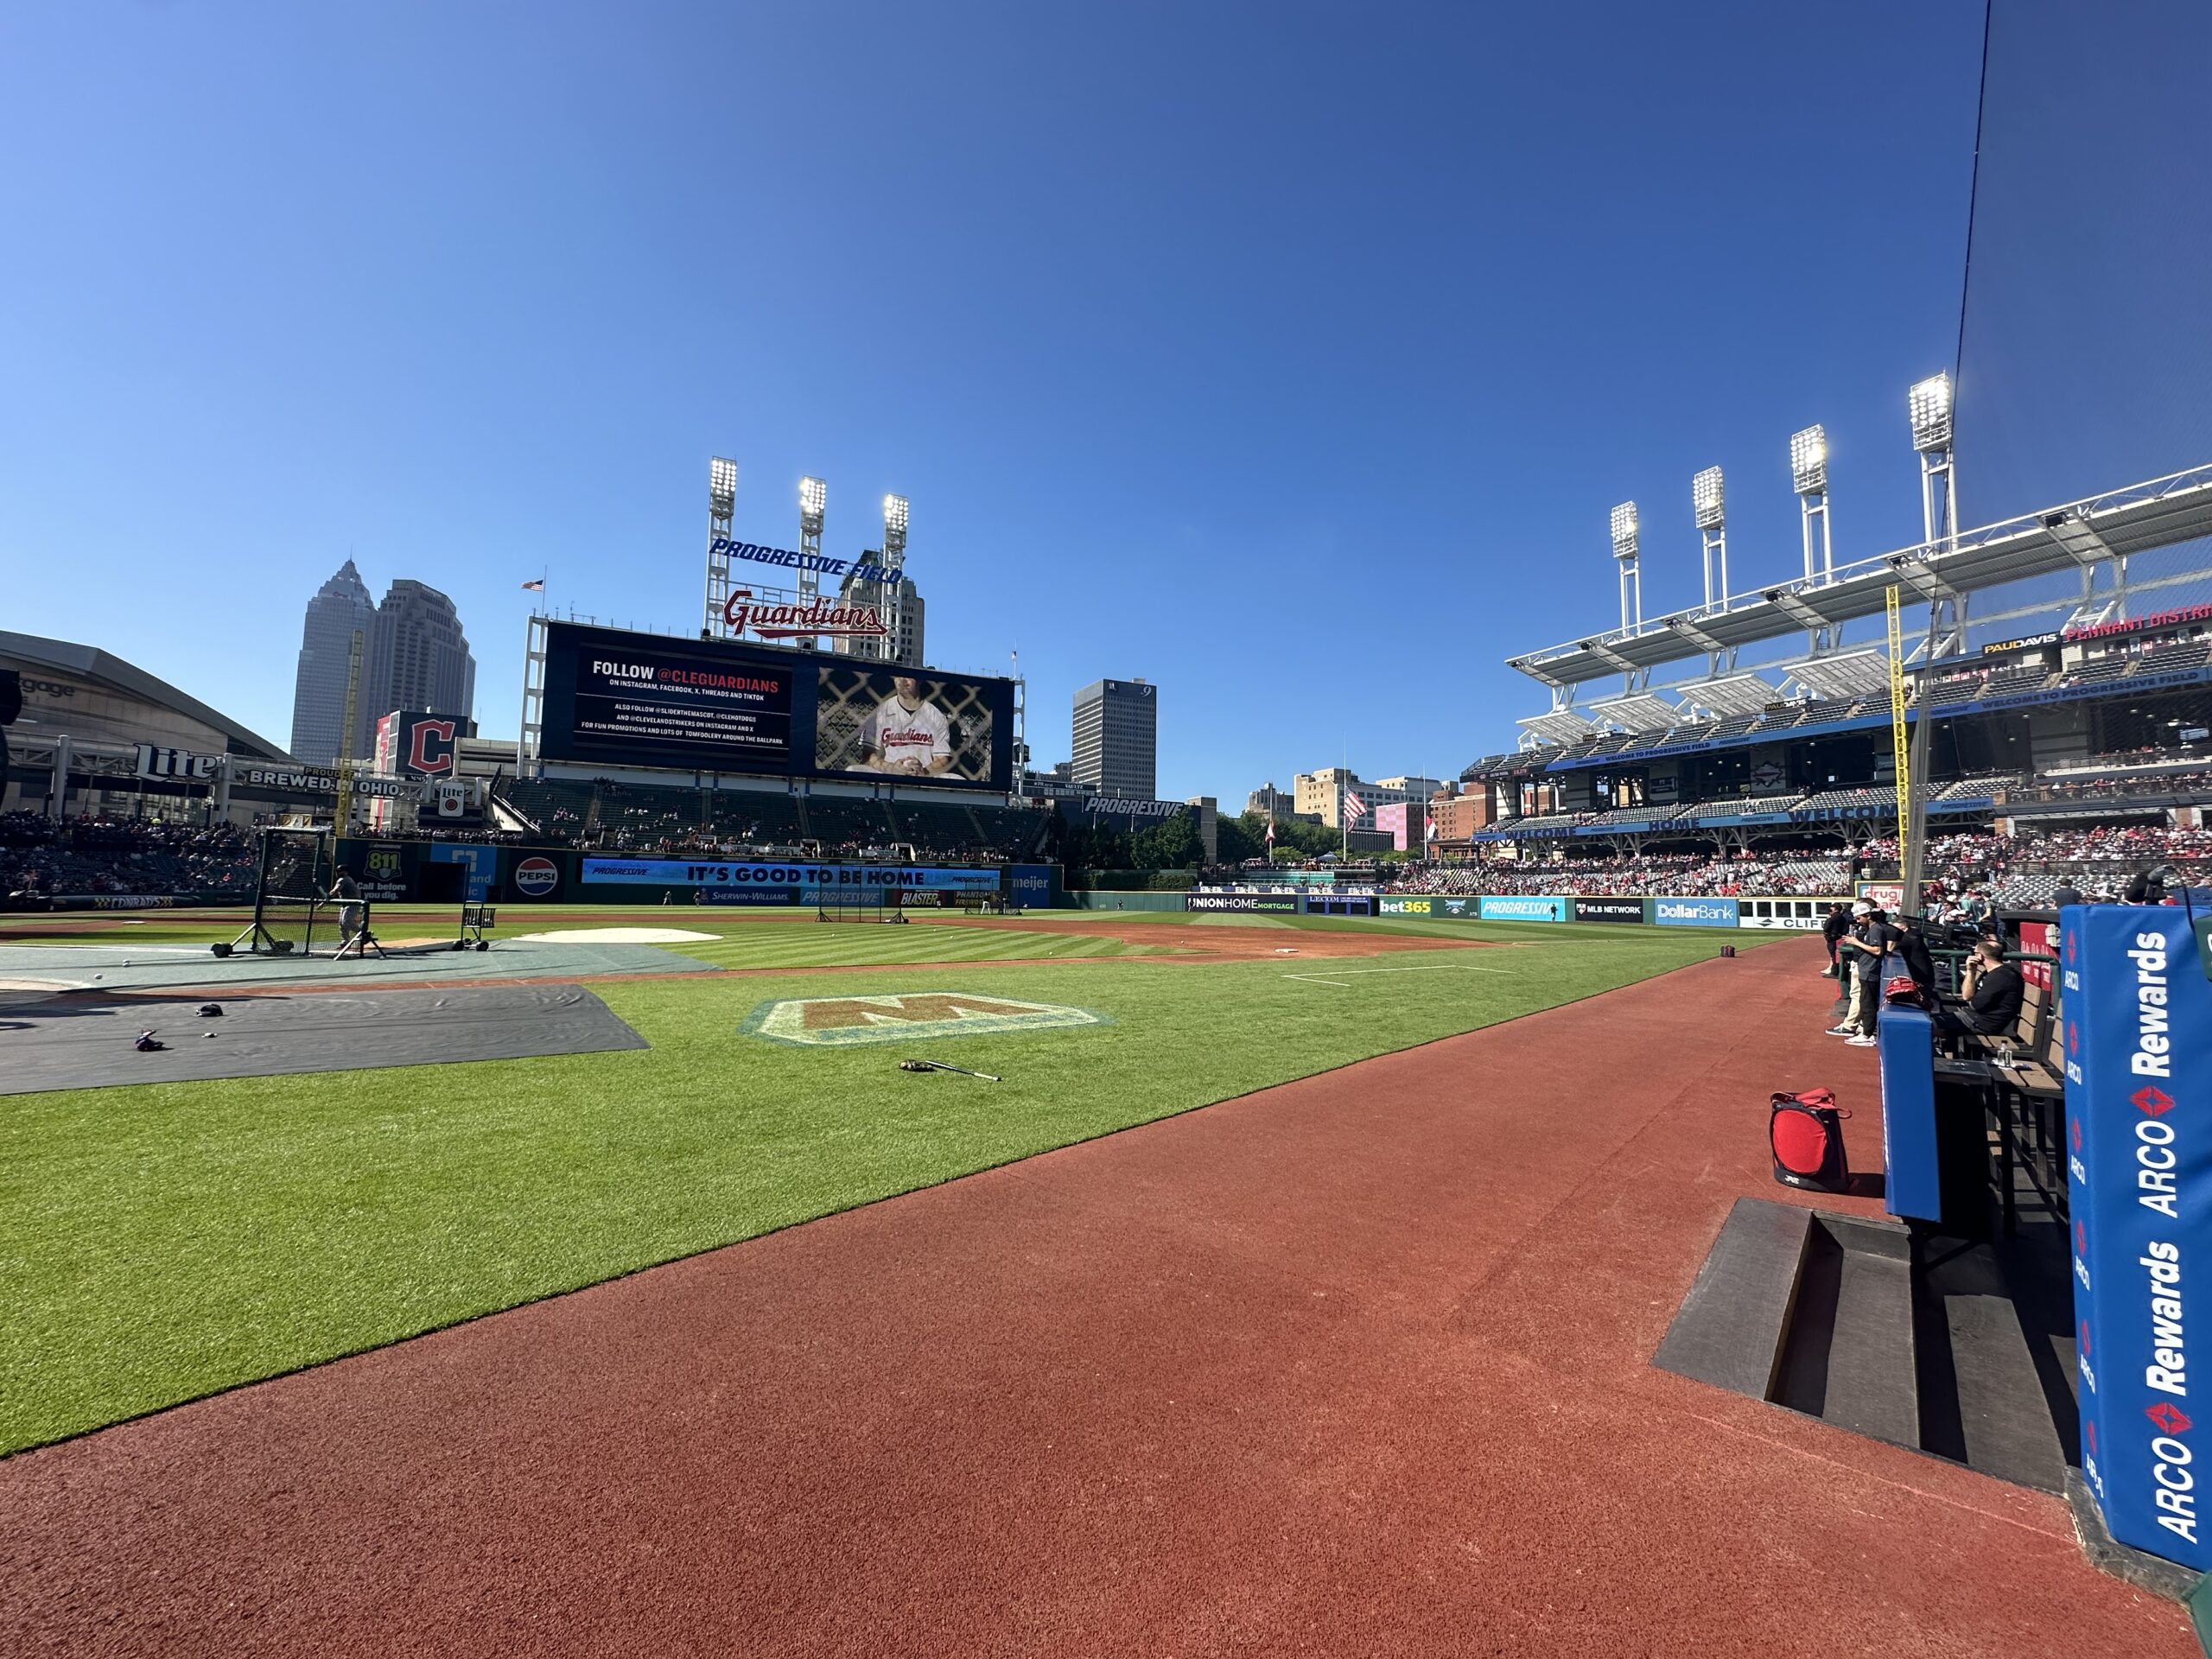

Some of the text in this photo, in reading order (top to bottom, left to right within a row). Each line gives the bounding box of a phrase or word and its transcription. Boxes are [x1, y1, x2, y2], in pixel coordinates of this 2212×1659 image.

[709, 537, 903, 584] PROGRESSIVE FIELD
[723, 588, 888, 639] Guardians
[2066, 604, 2212, 641] PENNANT DISTRI
[593, 661, 779, 693] FOLLOW @CLEGUARDIANS
[620, 680, 659, 690] INSTAGRAM,
[659, 684, 694, 694] FACEBOOK,
[702, 689, 728, 697] THREADS
[1141, 686, 1152, 697] 9
[1981, 671, 2199, 709] WELCOME TO PROGRESSIVE FIELD
[630, 715, 695, 727] @CLEVELANDSTRIKERS
[715, 713, 756, 722] @CLEHOTDOGS
[607, 724, 646, 733] PROMOTIONS
[685, 730, 721, 740] TOMFOOLERY
[881, 728, 934, 747] Guardians
[409, 719, 455, 773] C
[1605, 752, 1634, 761] WELCOME
[1645, 745, 1691, 756] PROGRESSIVE
[130, 743, 216, 782] Lite
[250, 770, 331, 790] BREWED
[359, 780, 400, 796] OHIO
[442, 787, 462, 798] Lite
[1085, 797, 1184, 817] PROGRESSIVE
[1788, 804, 1898, 823] WELCOM
[1648, 818, 1700, 831] HOME
[1505, 827, 1576, 840] WELCOME
[368, 852, 397, 870] 811
[518, 871, 556, 880] PEPSI
[592, 867, 649, 876] PROGRESSIVE
[687, 866, 925, 886] IT'S GOOD TO BE HOME
[357, 881, 406, 891] Call before
[1013, 876, 1048, 891] meijer
[364, 891, 398, 900] you dig.
[802, 891, 880, 903] PROGRESSIVE
[900, 893, 938, 906] BLASTER
[1865, 886, 1897, 901] drug
[1380, 900, 1431, 913] bet365
[1604, 906, 1641, 914] NETWORK
[2064, 969, 2079, 991] ARCO
[2067, 1059, 2082, 1085] ARCO
[2127, 931, 2178, 1219] ARCO Rewards
[2070, 1154, 2086, 1186] ARCO
[2075, 1255, 2091, 1292] ARCO
[2139, 1240, 2198, 1545] ARCO Rewards
